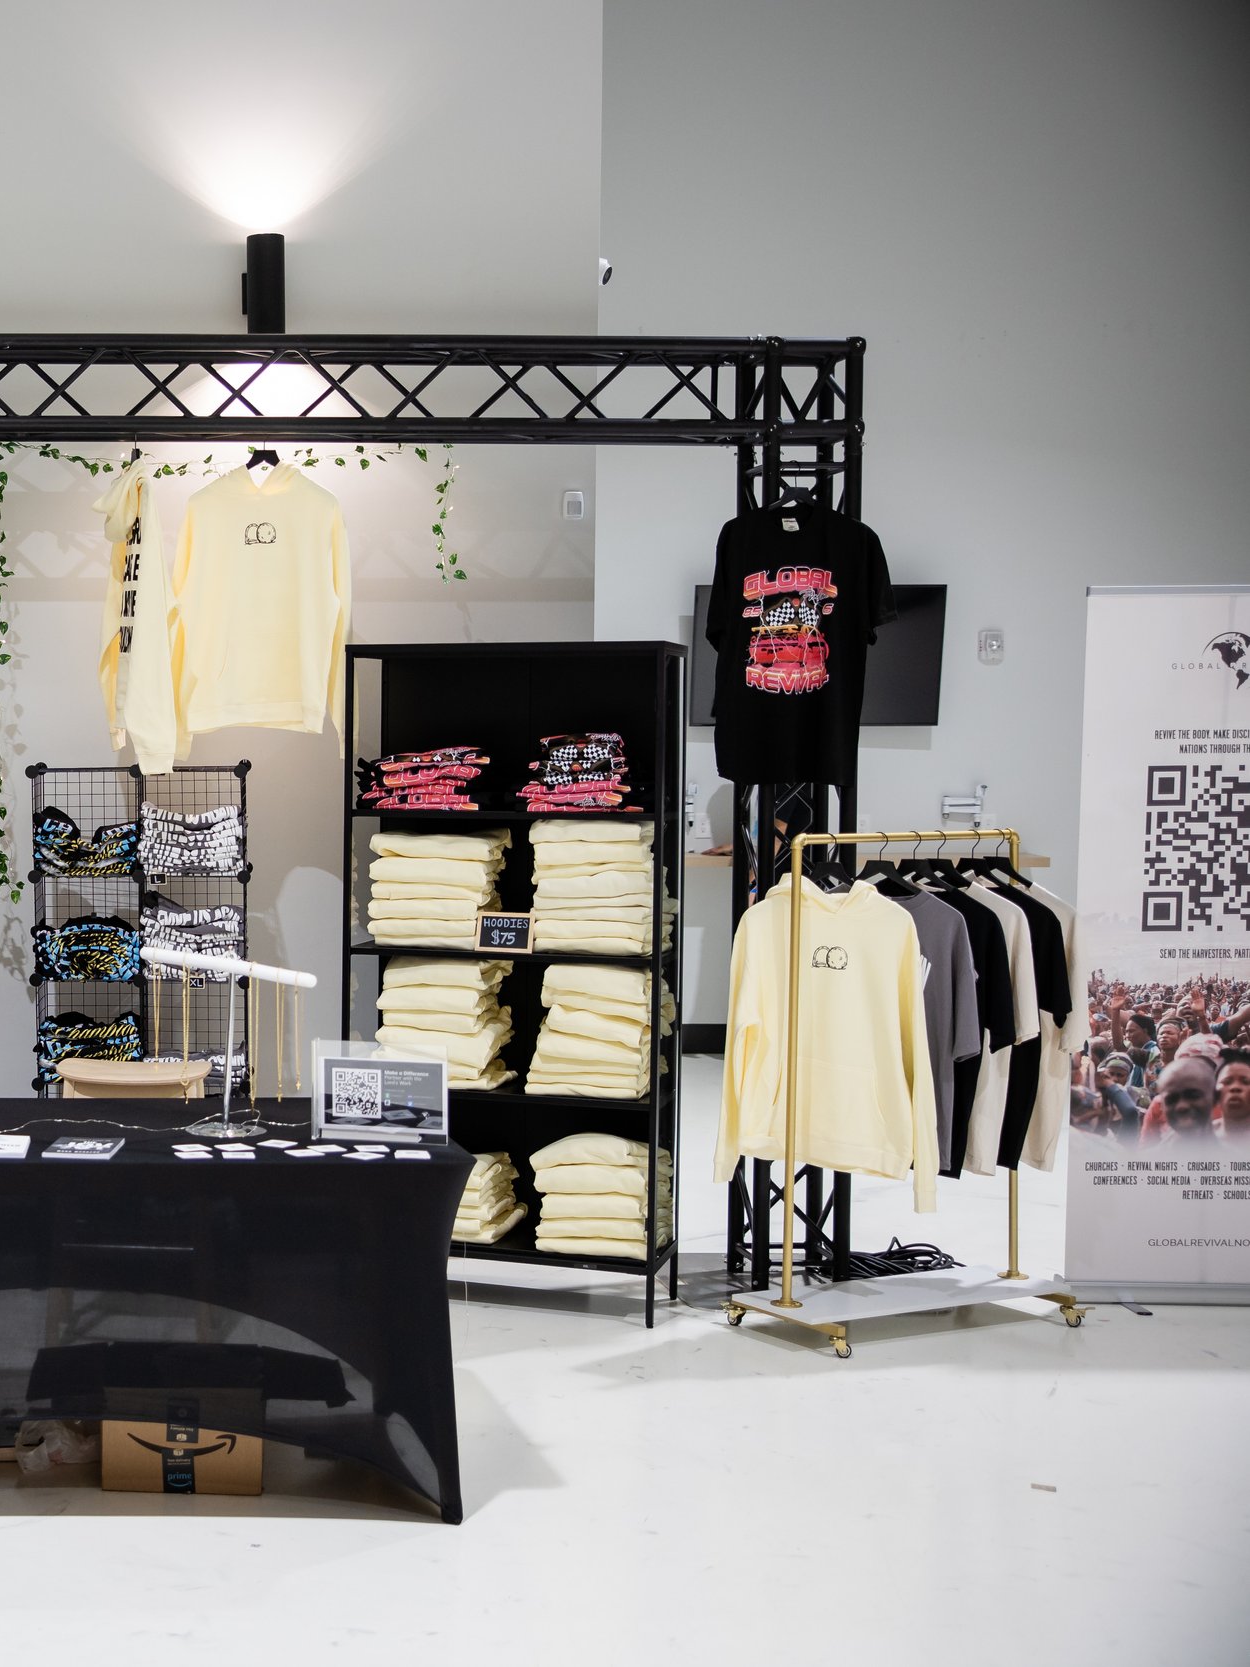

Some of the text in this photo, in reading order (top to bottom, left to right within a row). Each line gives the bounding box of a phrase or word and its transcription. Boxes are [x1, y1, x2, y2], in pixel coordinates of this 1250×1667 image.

[743, 566, 838, 600] GLOBAL
[1154, 729, 1176, 739] REVIVE
[1178, 729, 1190, 739] THE
[1192, 729, 1211, 739] BODY.
[1213, 729, 1231, 739] MAKE
[1179, 744, 1208, 754] NATIONS
[1210, 744, 1241, 754] THROUGH
[483, 918, 529, 930] HOODIES
[491, 929, 516, 945] $75
[1159, 948, 1250, 959] SEND THE HARVESTERS, PART
[1085, 1161, 1118, 1172] CHURCHES
[1127, 1161, 1152, 1172] REVIVAL
[1154, 1161, 1178, 1172] NIGHTS
[1187, 1161, 1220, 1171] CRUSADES
[1093, 1176, 1250, 1186] CONFERENCES SOCIAL MEDIA OVERSEAS MISS
[1182, 1190, 1214, 1200] RETREATS
[1147, 1238, 1250, 1247] GLOBALREVIVALNO
[167, 1472, 192, 1480] prime
